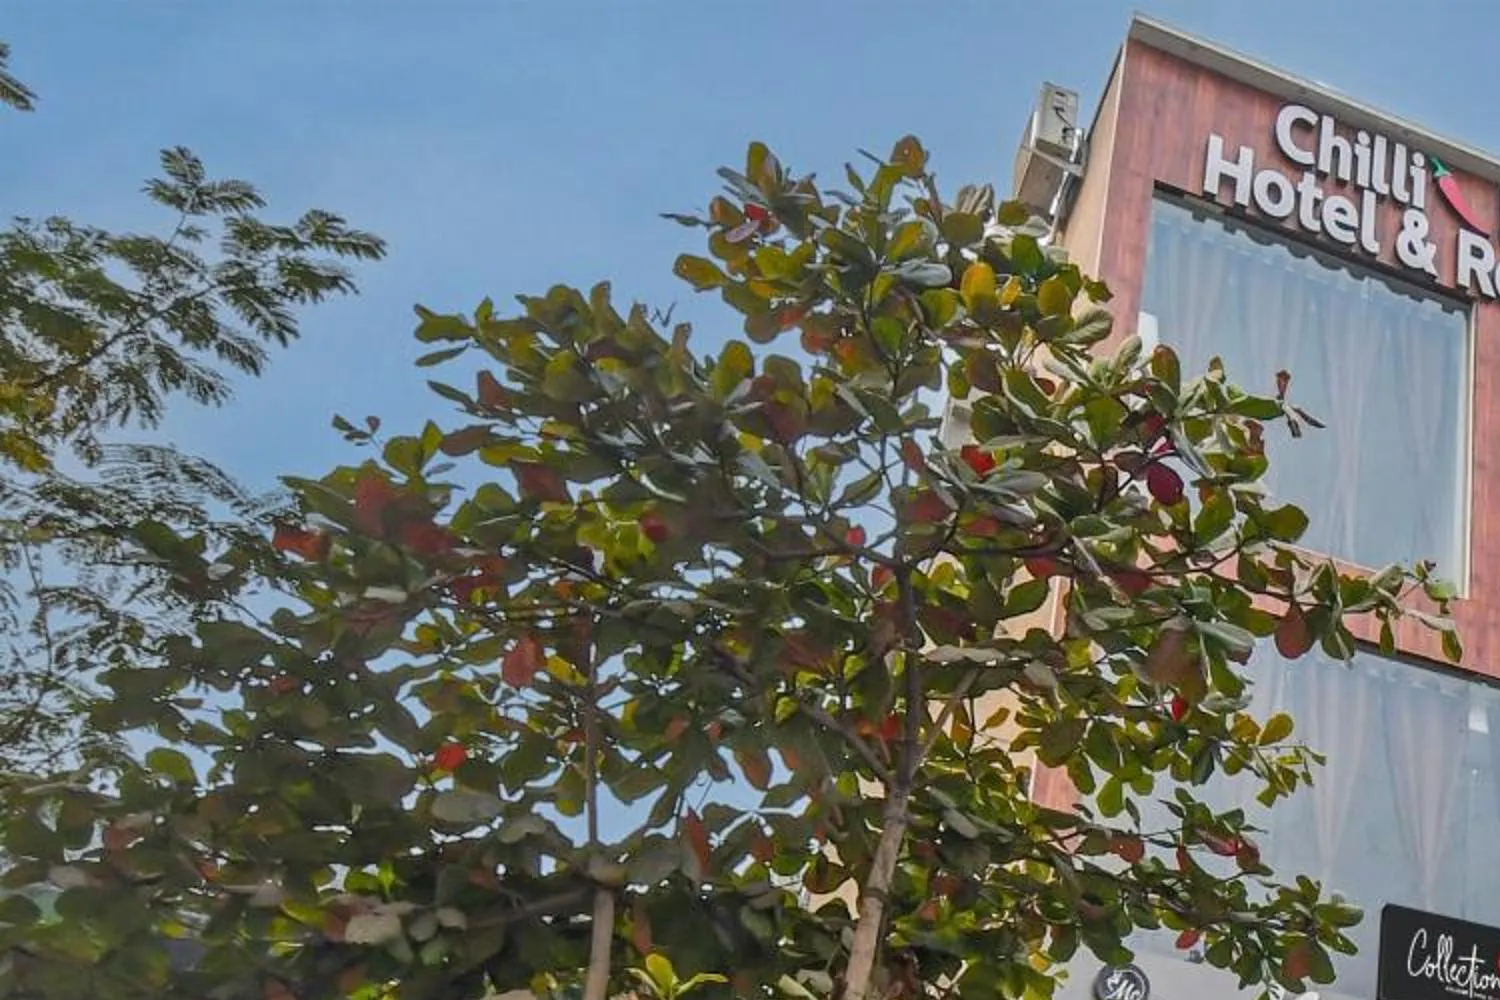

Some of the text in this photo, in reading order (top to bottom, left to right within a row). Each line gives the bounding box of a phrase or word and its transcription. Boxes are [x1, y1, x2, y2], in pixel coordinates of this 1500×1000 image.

[1203, 133, 1380, 255] Hotel
[1395, 210, 1437, 276] &
[1275, 104, 1426, 210] Chilli
